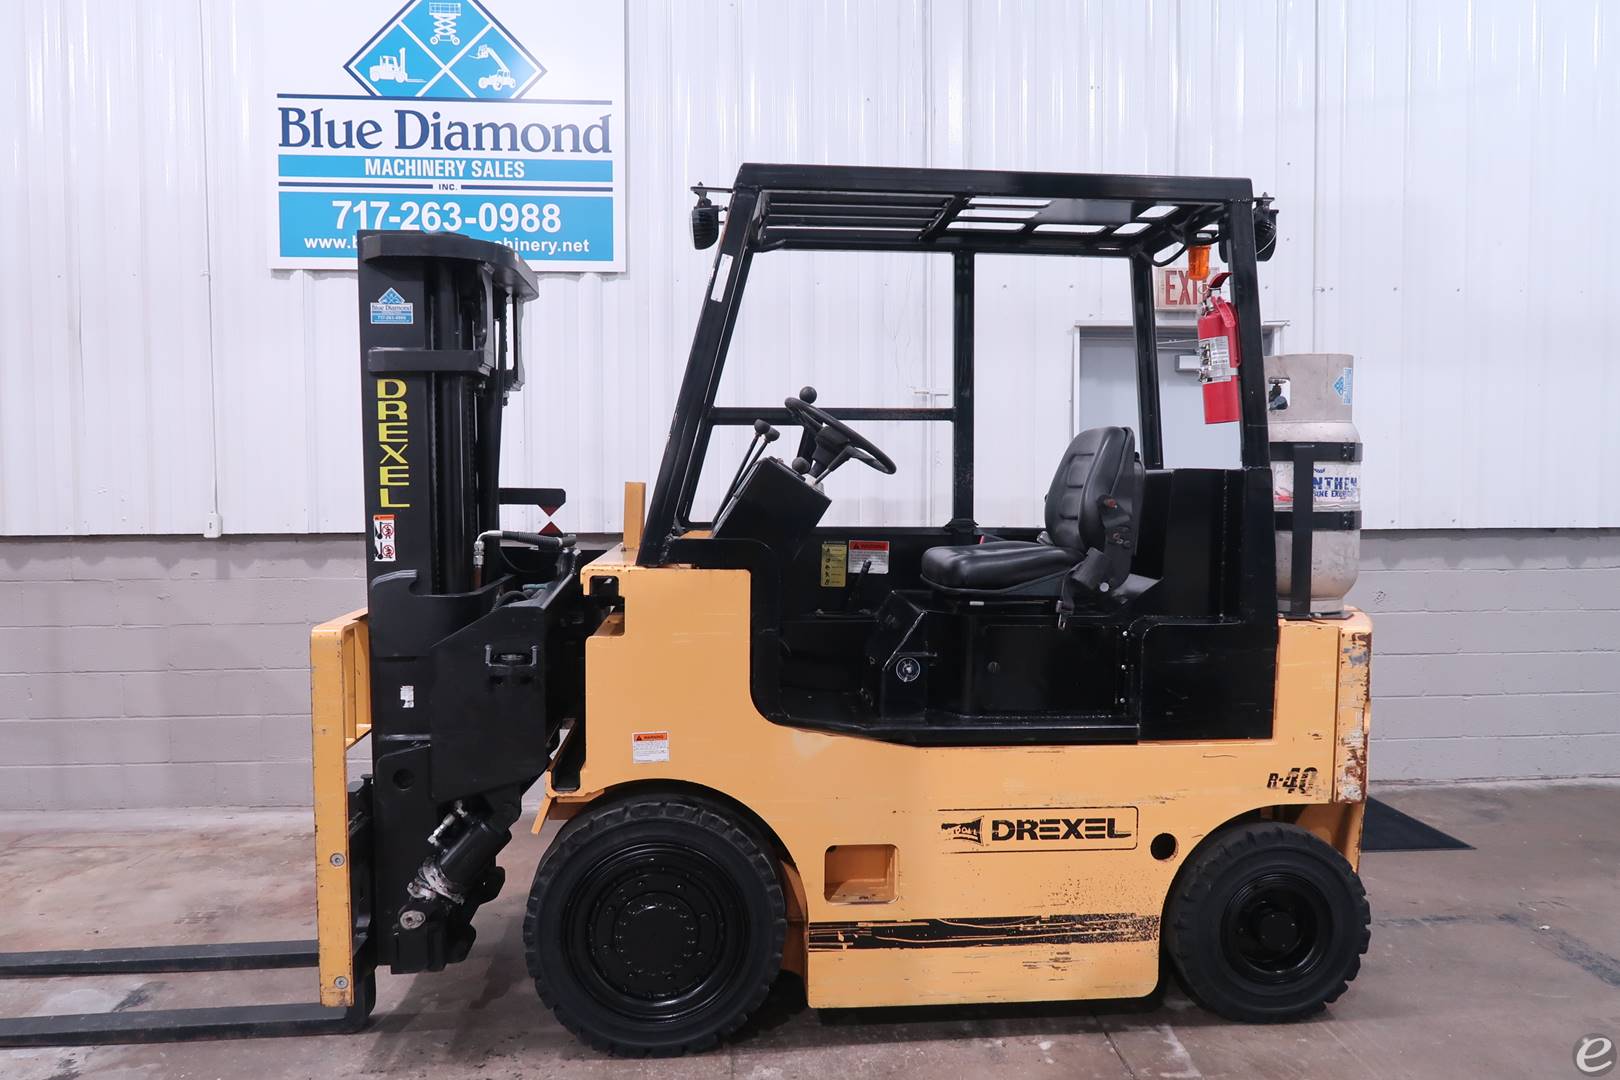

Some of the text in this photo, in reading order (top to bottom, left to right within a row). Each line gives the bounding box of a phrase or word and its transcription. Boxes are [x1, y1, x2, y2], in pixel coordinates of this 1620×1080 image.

[278, 107, 613, 153] Blue Diamond
[364, 158, 525, 179] MACHINERY SALES
[438, 183, 458, 191] INC.
[332, 200, 561, 233] 717-263-0988
[376, 378, 410, 508] DREXEL
[991, 817, 1132, 841] DREXEL
